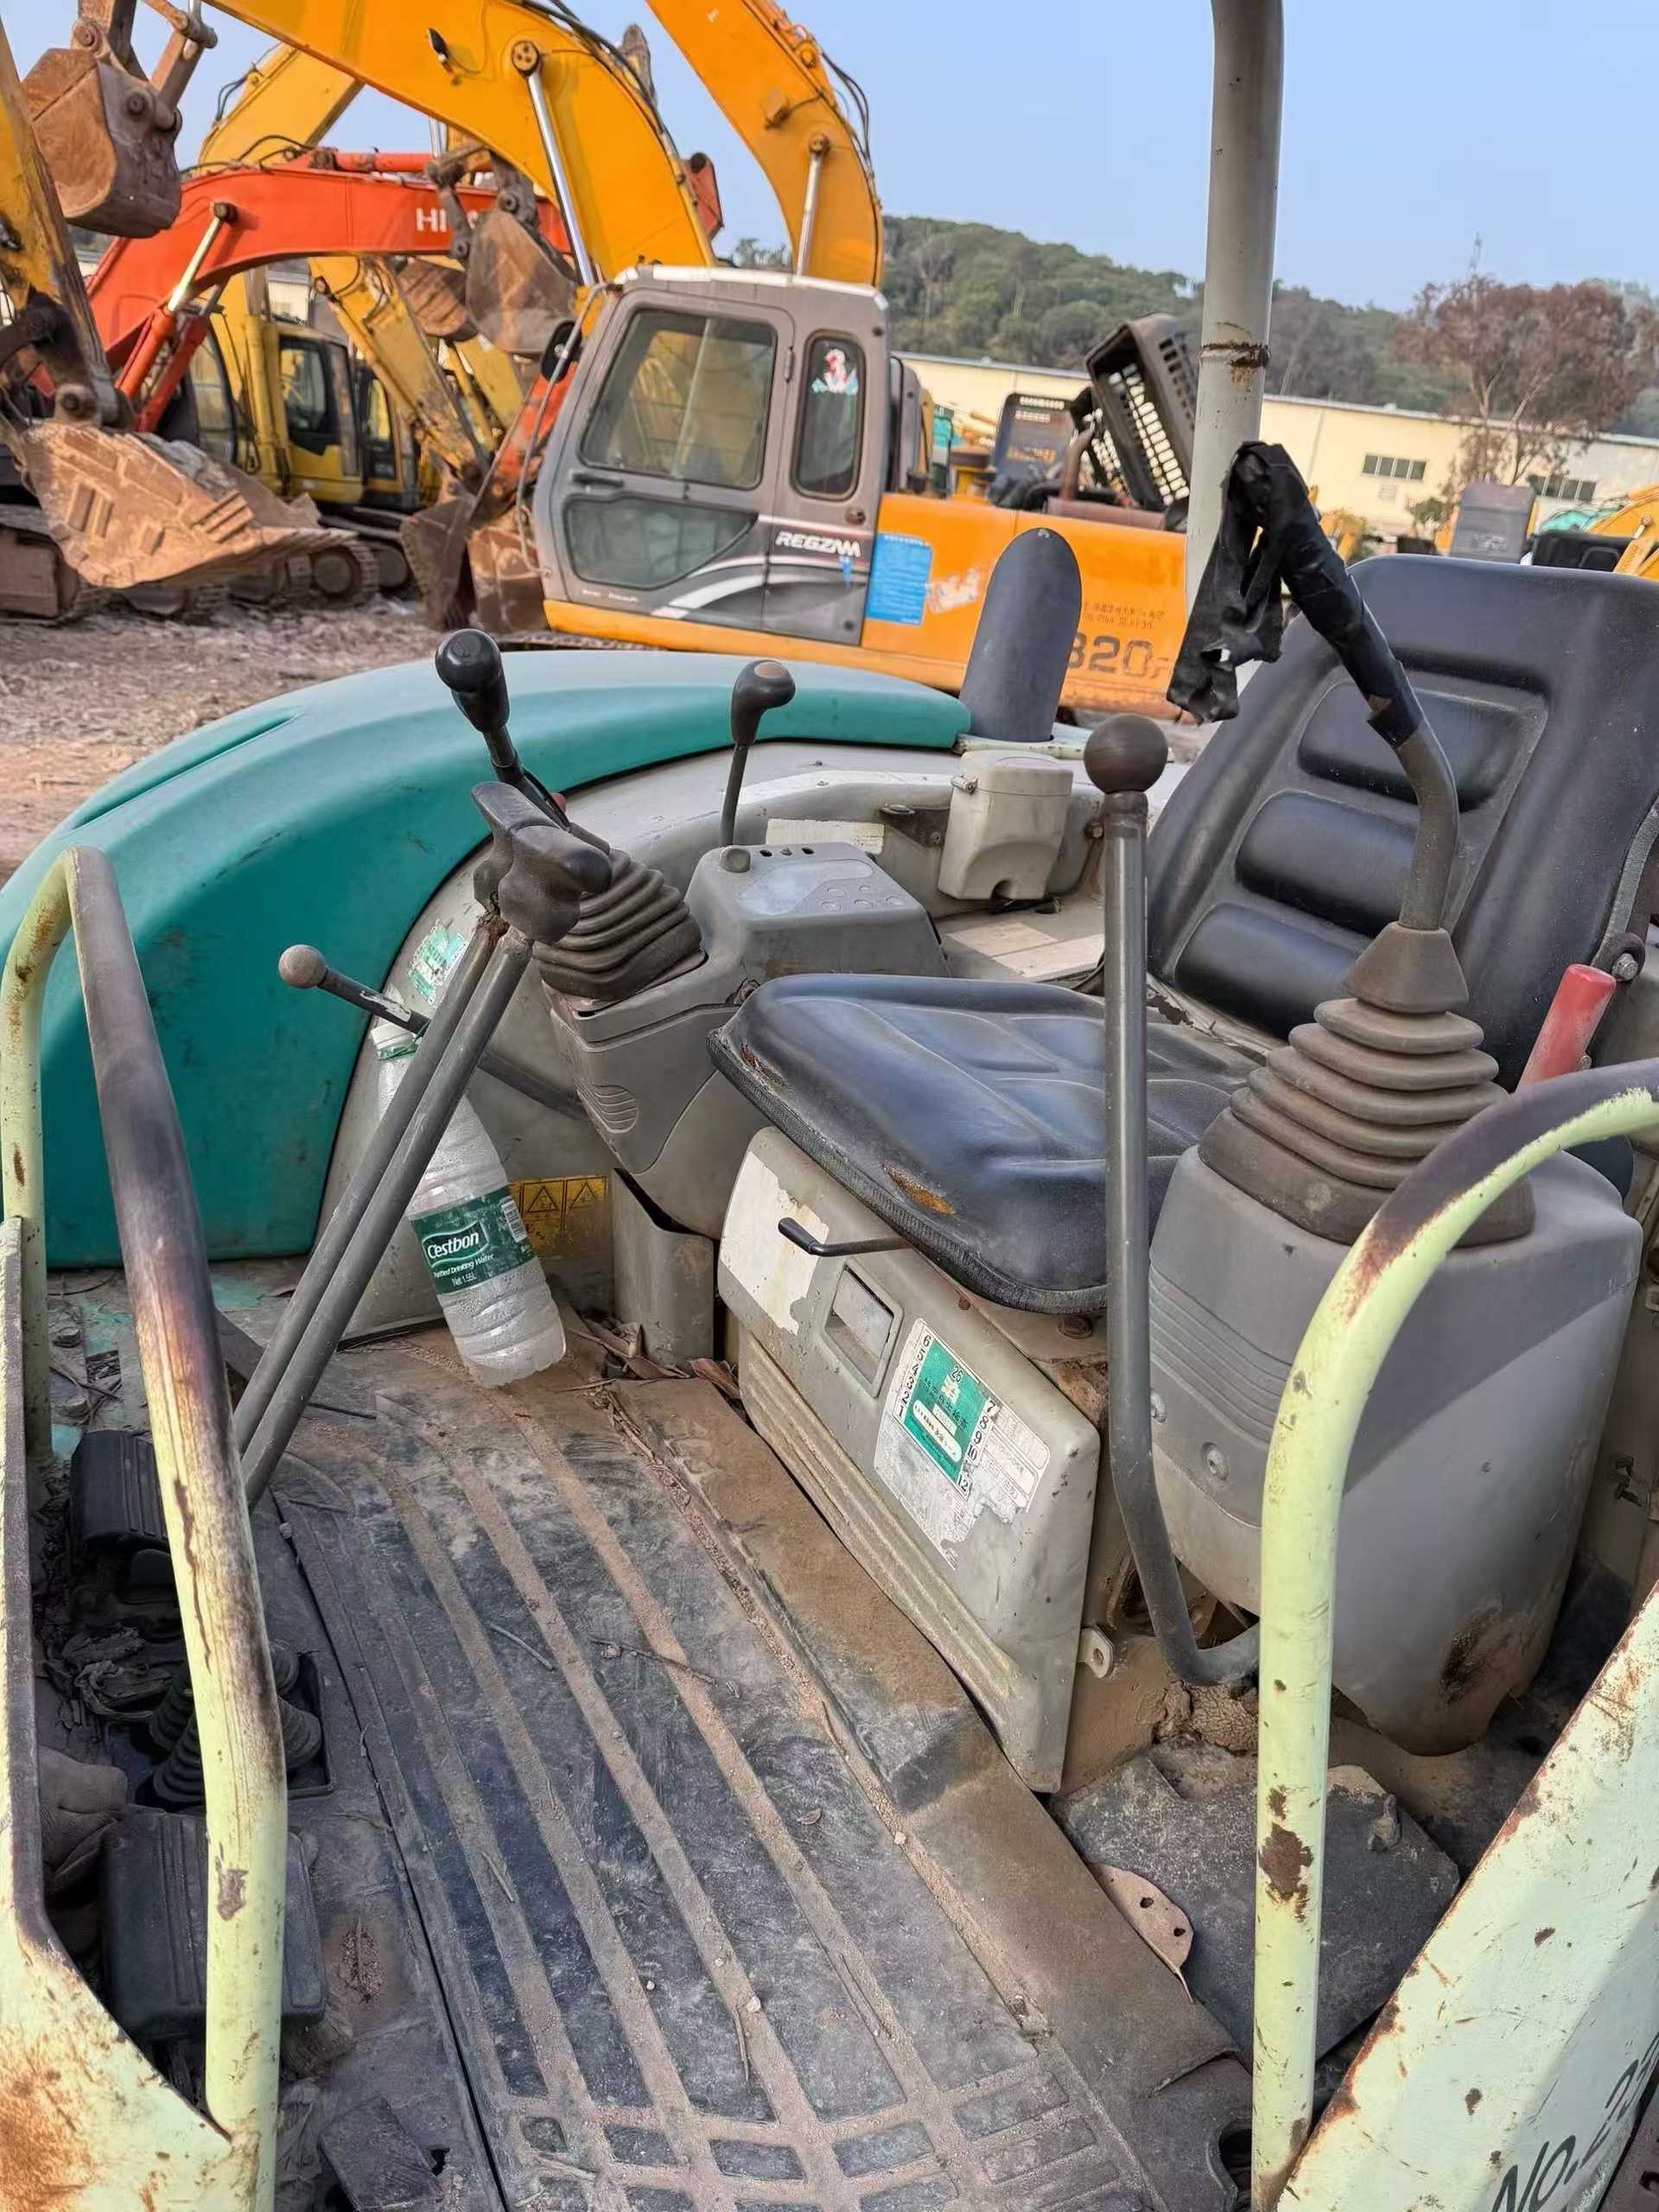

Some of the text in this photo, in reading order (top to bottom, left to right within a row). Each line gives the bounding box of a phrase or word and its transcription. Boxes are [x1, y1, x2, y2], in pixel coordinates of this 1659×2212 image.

[450, 1261, 474, 1274] Drinking
[474, 1254, 494, 1265] Water
[451, 1277, 463, 1287] Net
[923, 1335, 931, 1347] 6
[917, 1348, 925, 1361] 5
[912, 1363, 919, 1376] 4
[951, 1365, 963, 1382] 26
[906, 1376, 915, 1389] 3
[901, 1390, 910, 1404] 2
[899, 1405, 904, 1417] 1
[987, 1400, 996, 1413] 7
[979, 1415, 989, 1429] 8
[974, 1430, 982, 1444] 9
[967, 1444, 978, 1461] 10
[958, 1475, 969, 1492] 12
